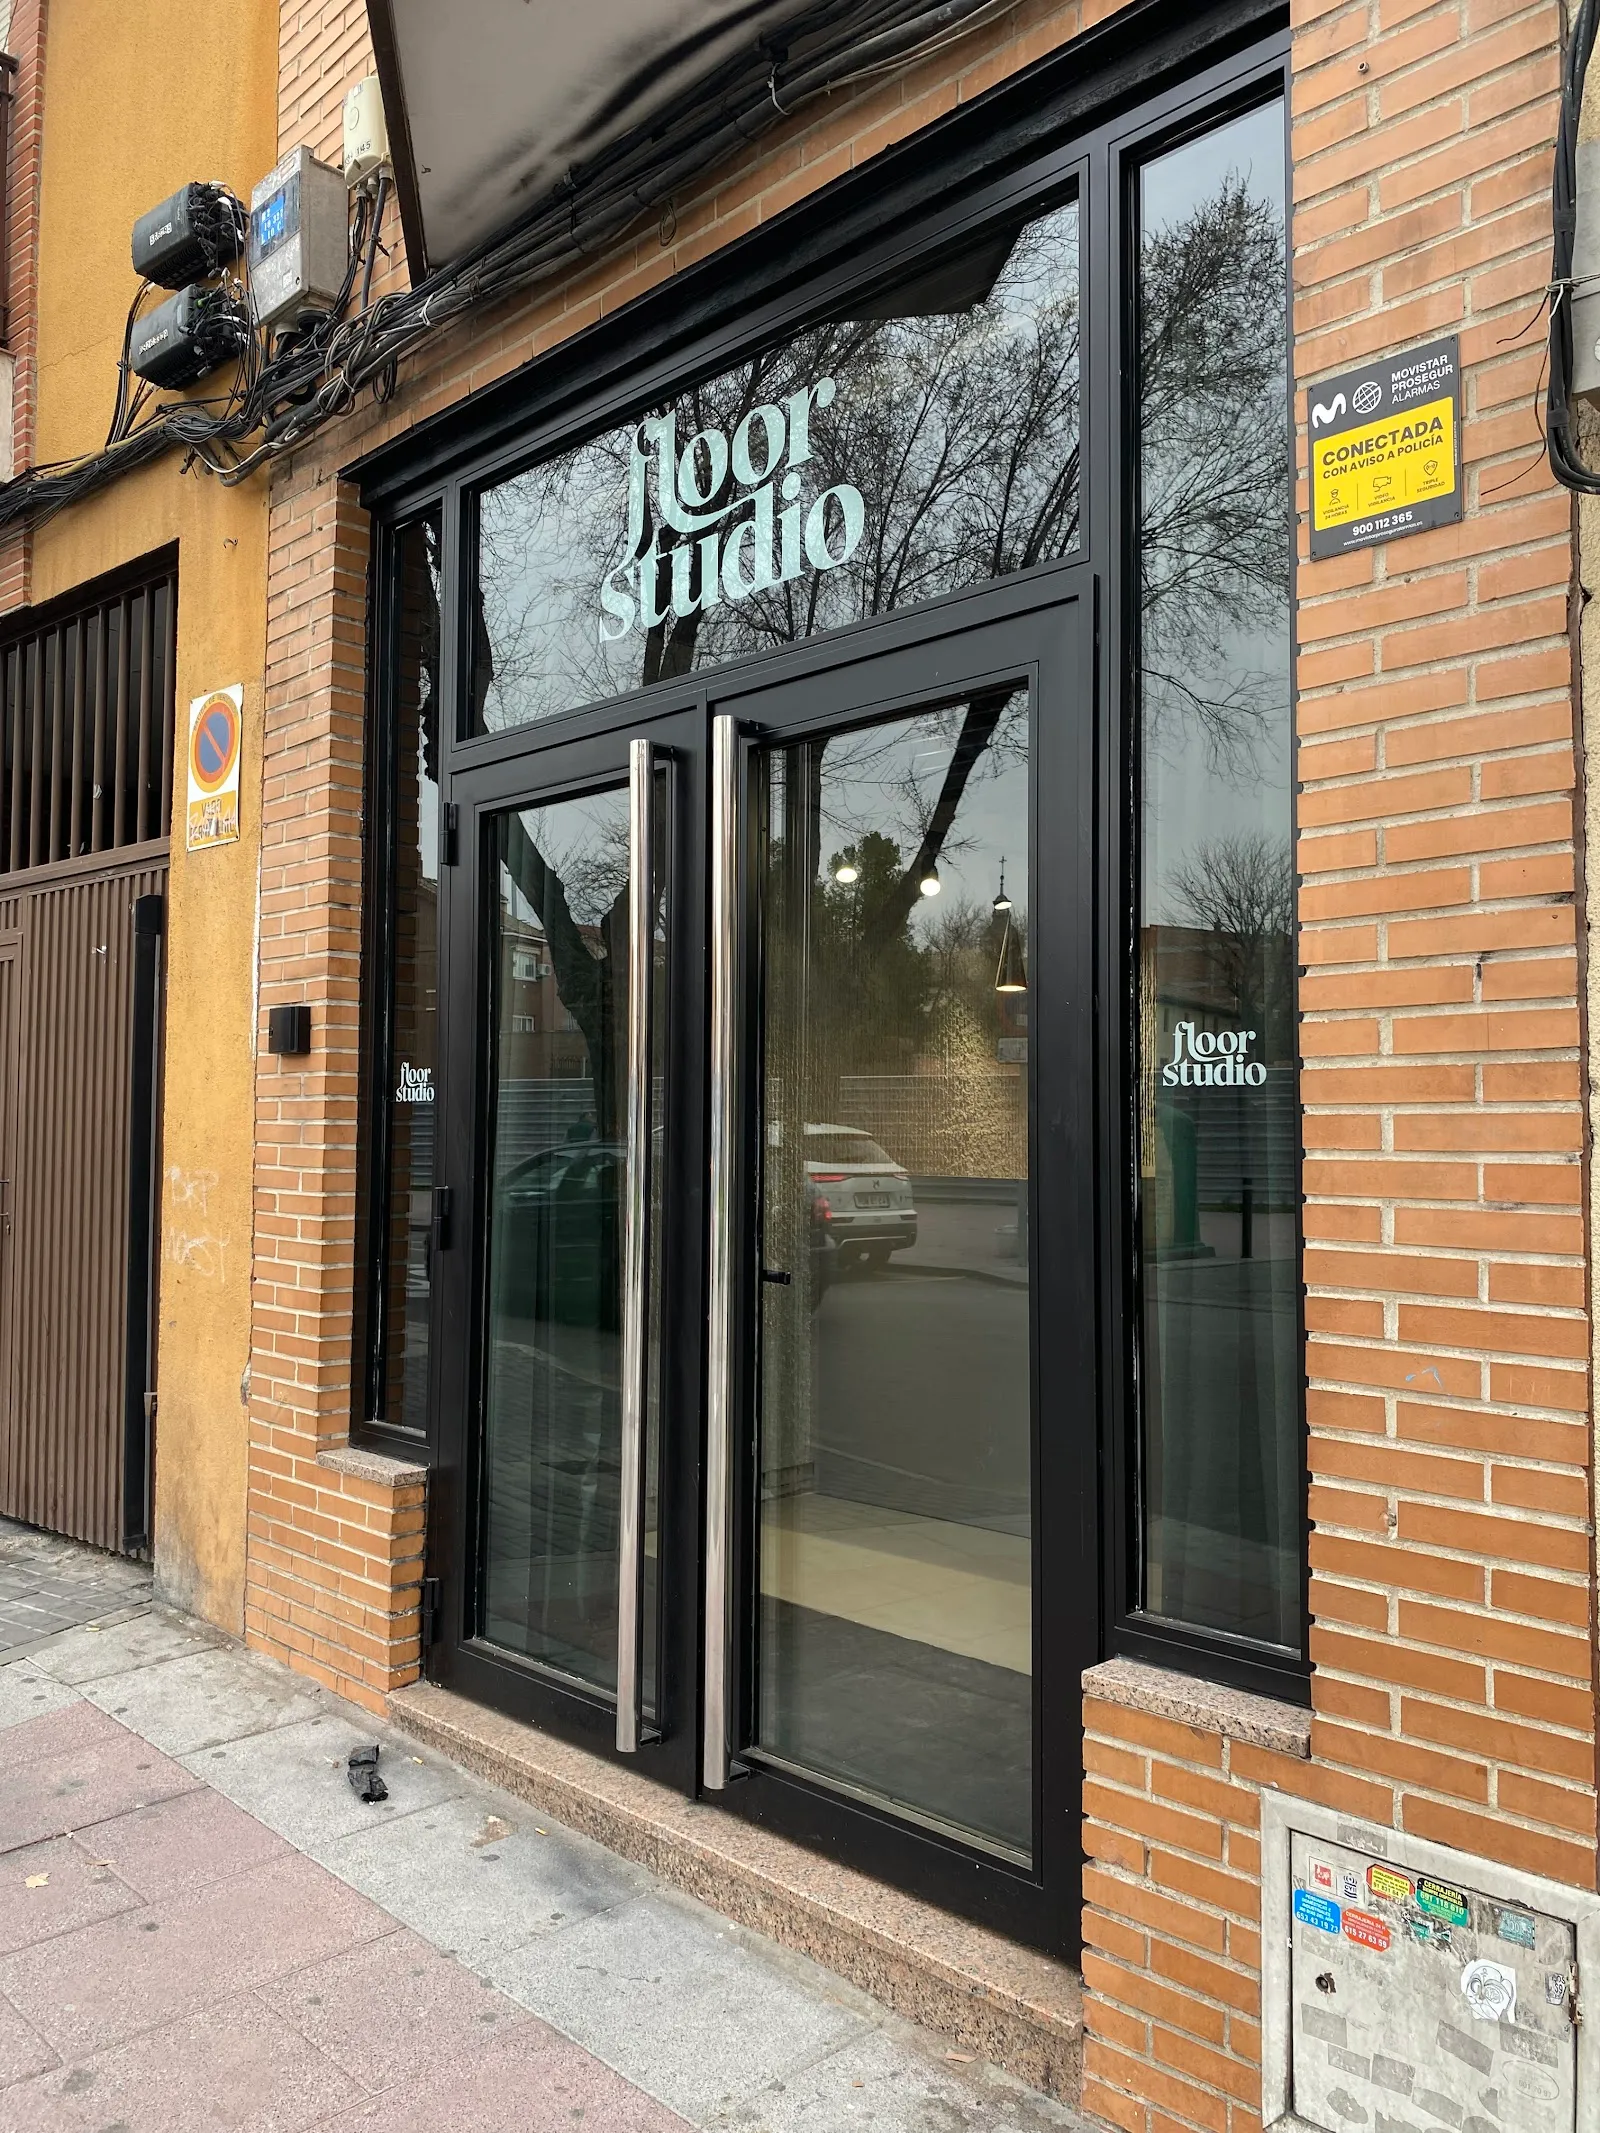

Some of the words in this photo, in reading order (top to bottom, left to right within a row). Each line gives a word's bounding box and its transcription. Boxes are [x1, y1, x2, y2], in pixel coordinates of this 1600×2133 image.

[1391, 354, 1448, 383] MOVISTAR
[1391, 364, 1454, 394] PROSEGUR
[1391, 380, 1441, 404] ALARMAS
[1322, 416, 1444, 466] CONECTADA
[622, 377, 836, 540] floor
[1323, 464, 1347, 480] CON
[1350, 453, 1385, 472] AVISO
[1387, 450, 1395, 461] A
[1397, 434, 1443, 457] POLICÍA
[1422, 477, 1439, 486] TRIPLE
[1352, 521, 1374, 536] 900
[1375, 517, 1390, 530] 112
[1391, 510, 1413, 526] 365
[600, 472, 865, 643] studio
[1172, 1021, 1257, 1062] floor
[400, 1061, 432, 1087] floor
[1162, 1054, 1267, 1087] studio
[395, 1082, 435, 1103] studio
[1420, 1891, 1434, 1902] 691
[1436, 1897, 1449, 1908] 118
[1450, 1903, 1464, 1915] 610
[1423, 1880, 1462, 1901] CERRAJERÍA
[1296, 1911, 1309, 1922] 653
[1310, 1916, 1319, 1926] 43
[1320, 1920, 1328, 1929] 19
[1330, 1924, 1339, 1934] 73
[1344, 1925, 1357, 1936] 615
[1358, 1930, 1367, 1940] 27
[1368, 1935, 1377, 1945] 63
